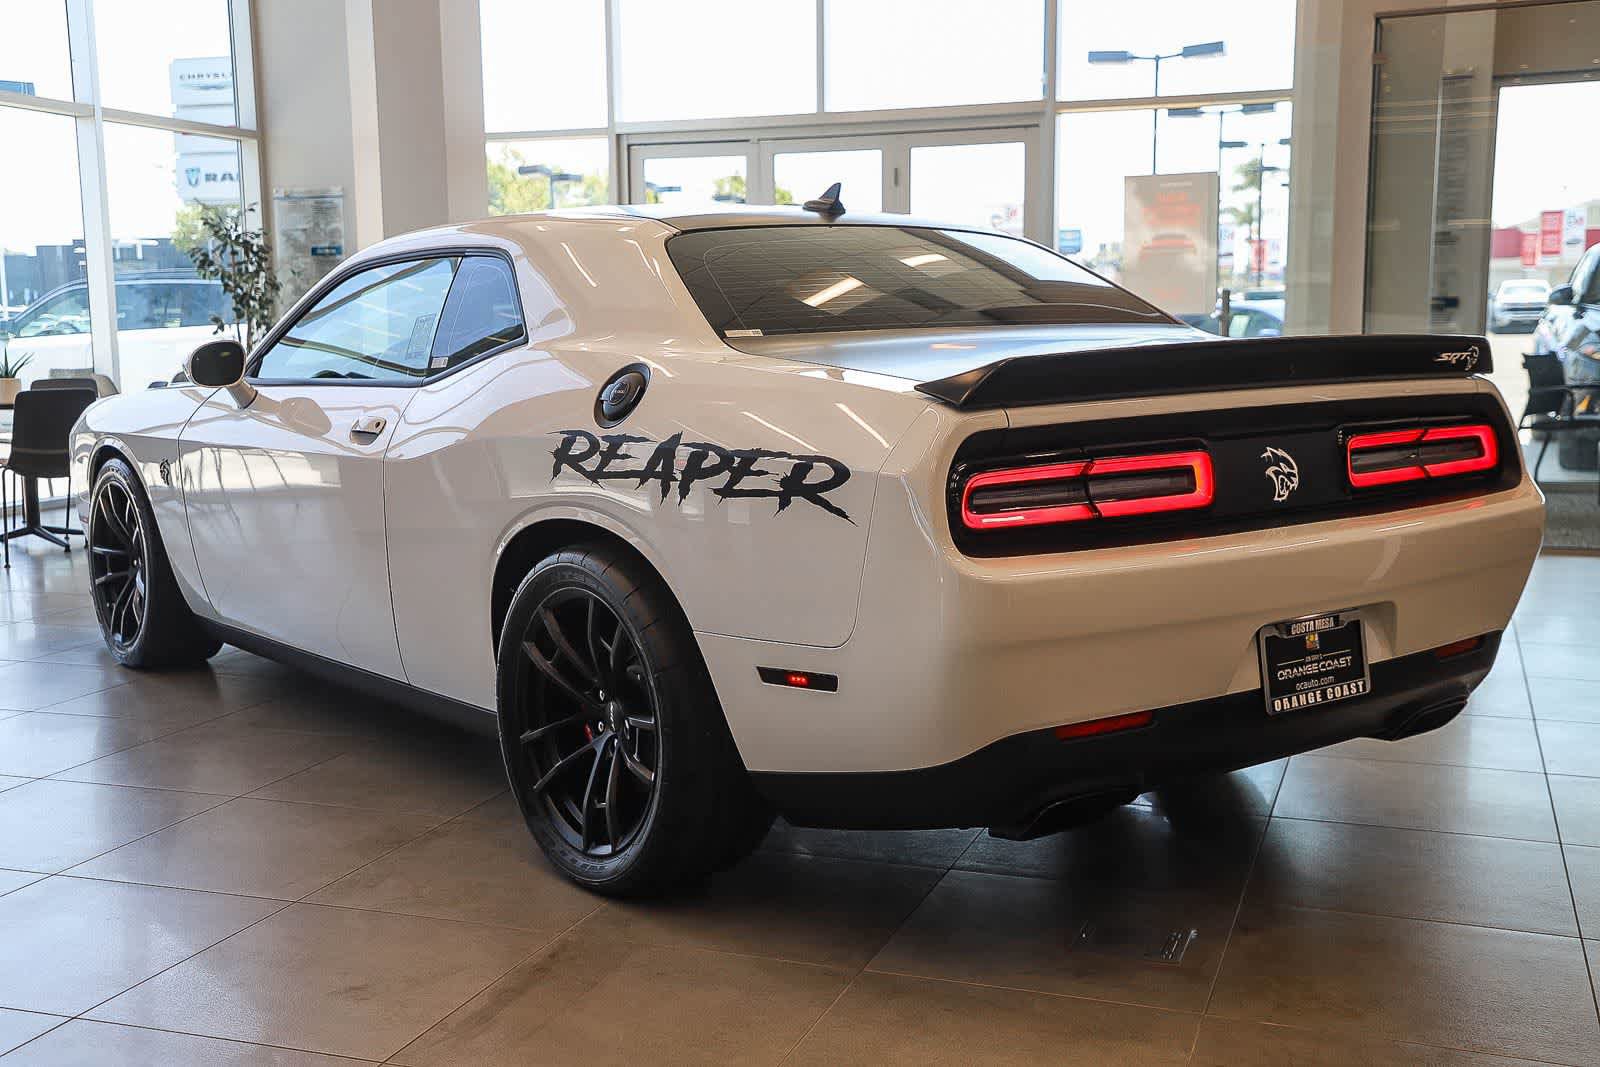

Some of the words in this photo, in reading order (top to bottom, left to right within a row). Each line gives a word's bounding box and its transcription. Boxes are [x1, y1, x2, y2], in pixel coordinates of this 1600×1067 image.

[204, 173, 239, 182] RA
[547, 429, 858, 527] REAPER
[1291, 621, 1315, 635] COSTA
[1315, 617, 1335, 630] MESA
[1296, 675, 1335, 691] ocauto.com
[1274, 690, 1322, 711] ORANGE
[1326, 681, 1364, 699] COAST
